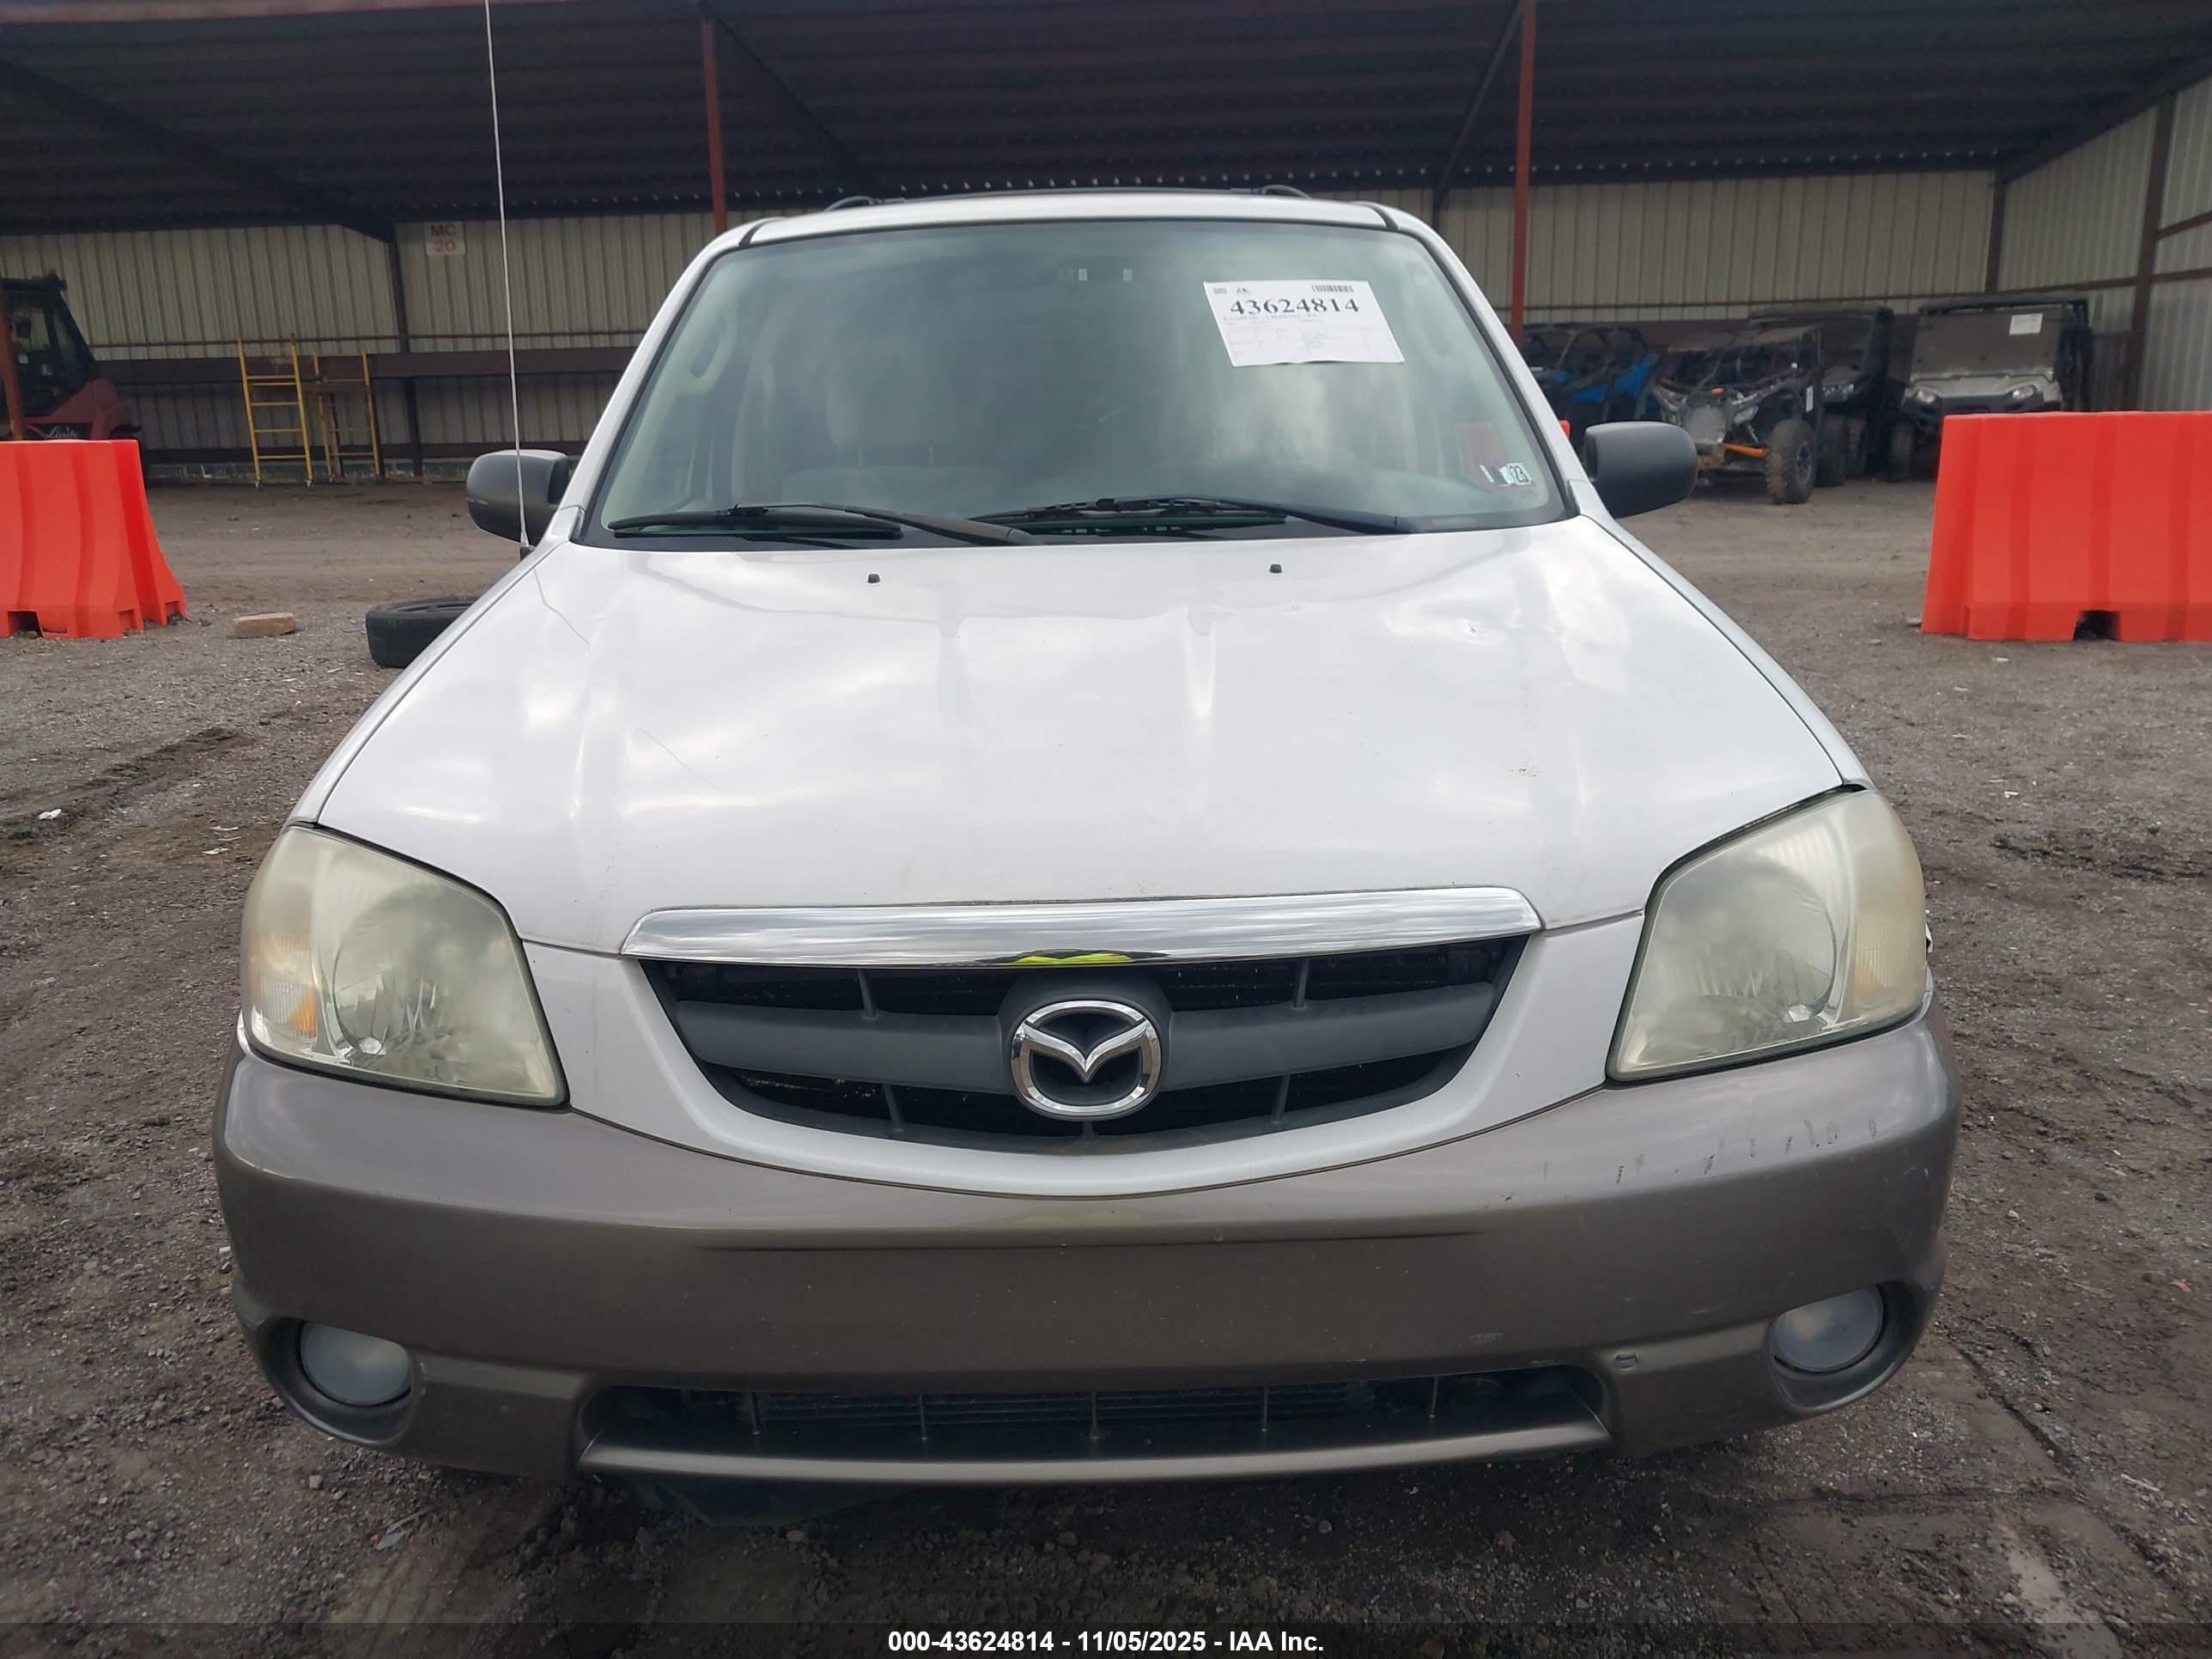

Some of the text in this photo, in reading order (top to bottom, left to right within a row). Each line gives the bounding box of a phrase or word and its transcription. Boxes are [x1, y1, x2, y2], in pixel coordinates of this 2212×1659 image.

[431, 224, 456, 236] MC
[434, 240, 455, 252] 20
[1231, 298, 1359, 314] 43624814
